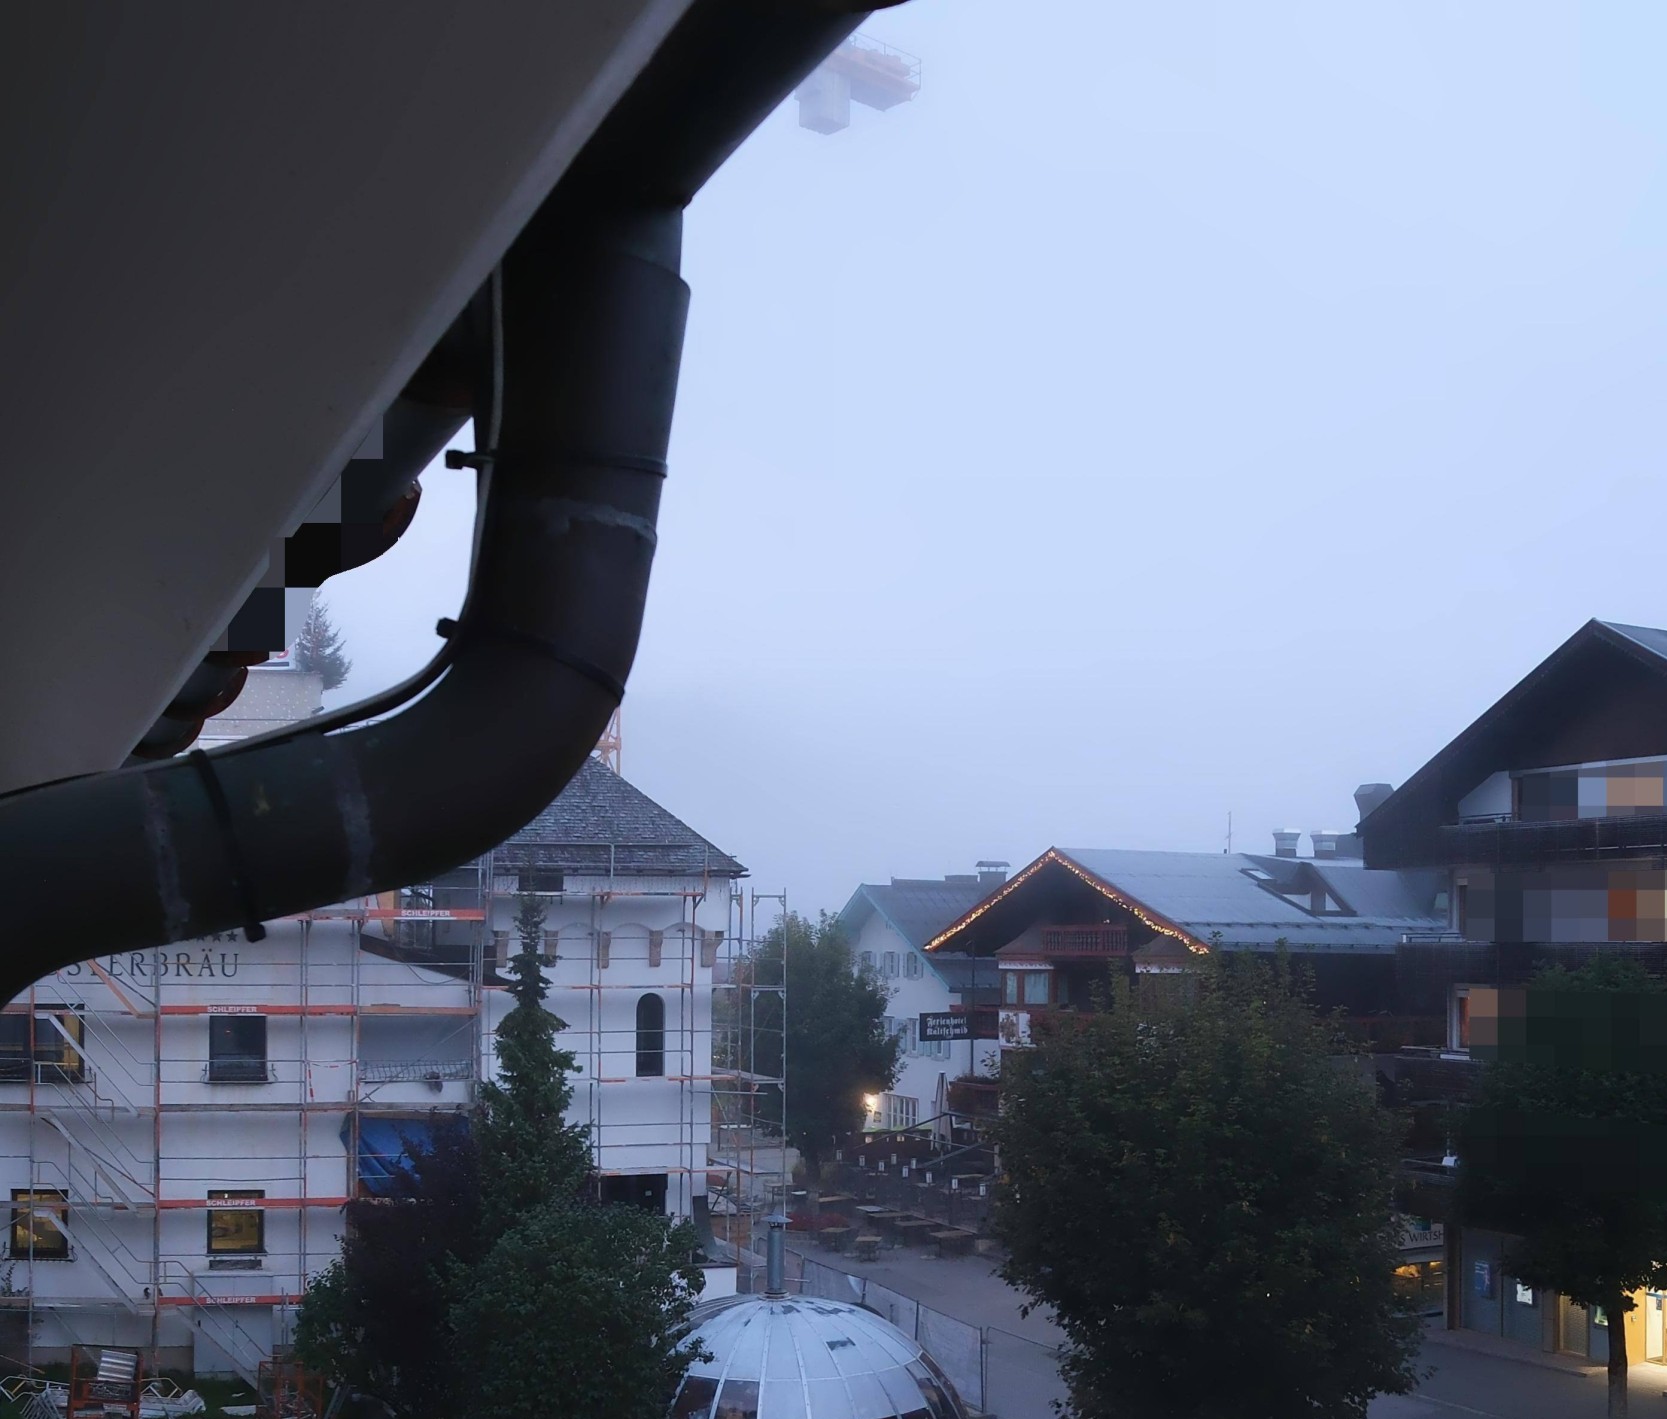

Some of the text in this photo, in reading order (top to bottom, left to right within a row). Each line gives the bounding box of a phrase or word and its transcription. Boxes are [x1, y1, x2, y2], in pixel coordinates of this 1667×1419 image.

[401, 909, 451, 917] SCHLEIPFER
[207, 1005, 257, 1013] SCHLEIPFER
[206, 1199, 256, 1207] SCHLEIPFER
[1409, 1230, 1444, 1243] WIRTSH
